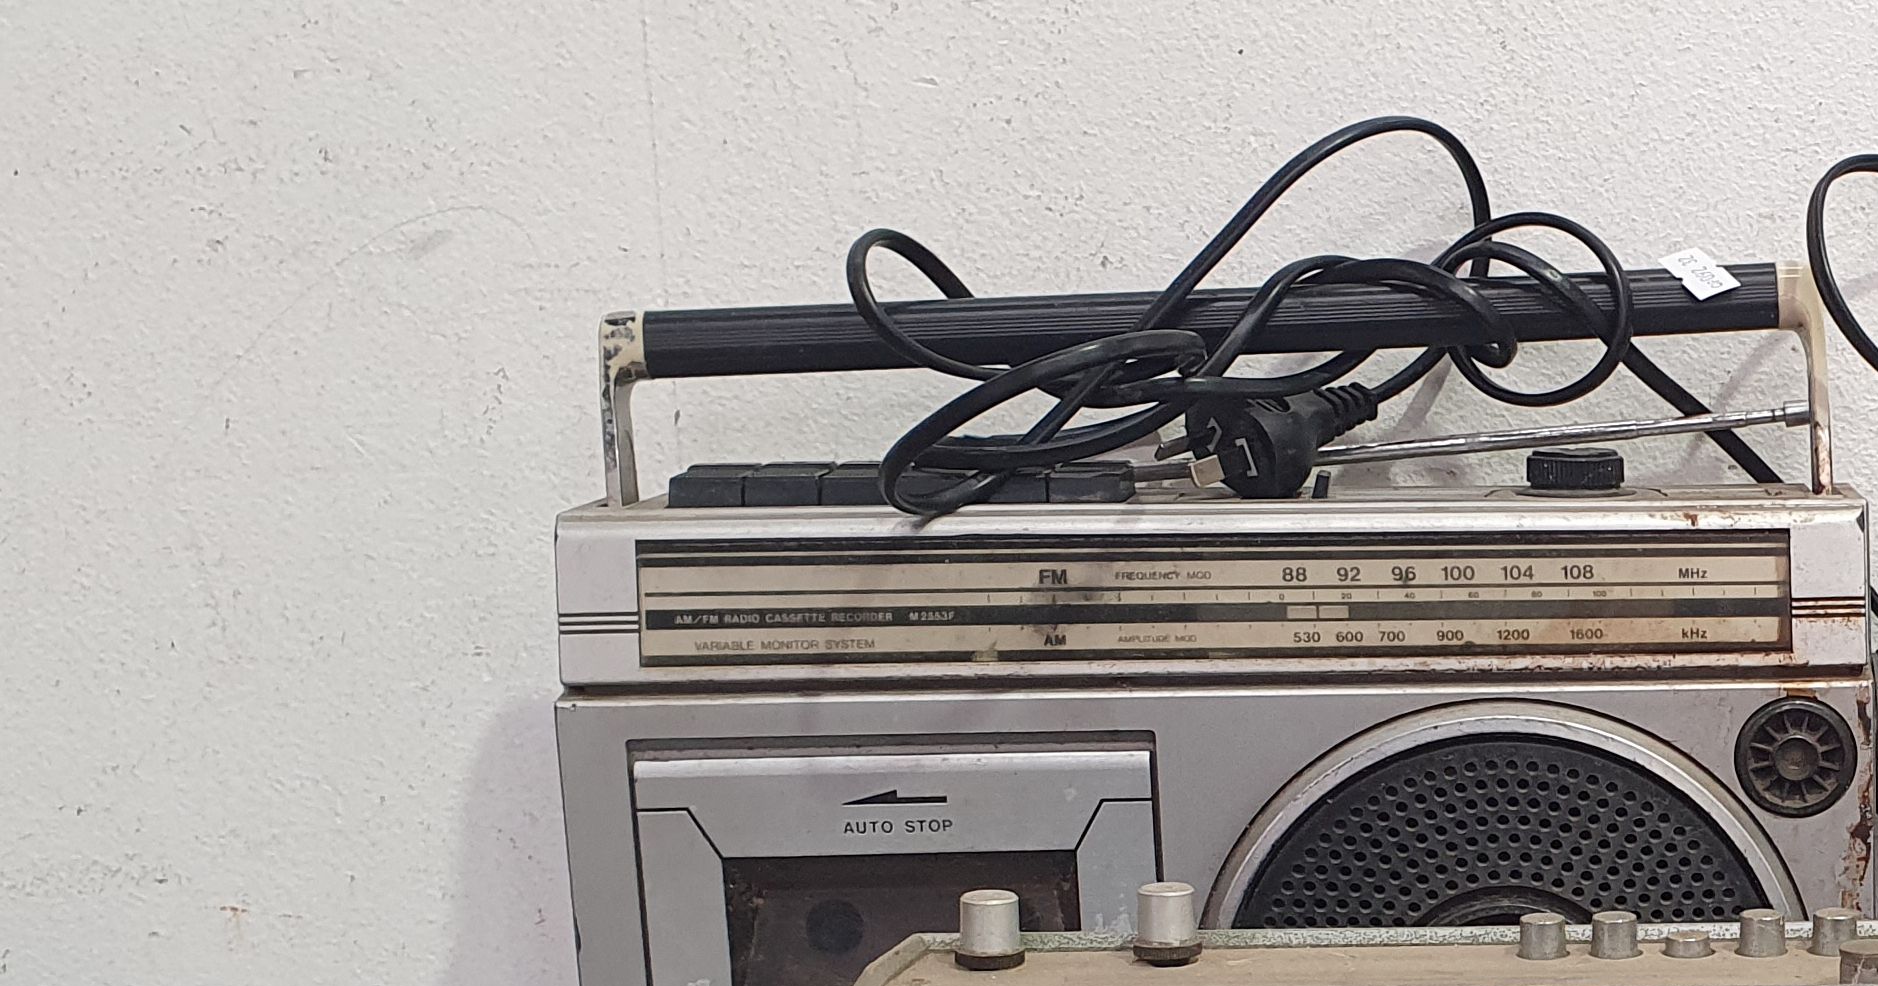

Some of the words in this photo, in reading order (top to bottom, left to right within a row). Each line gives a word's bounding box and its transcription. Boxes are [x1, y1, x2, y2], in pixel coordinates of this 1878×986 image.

[1039, 569, 1067, 585] FM
[1115, 571, 1180, 581] FREQUENCY
[1186, 570, 1212, 580] MOD
[1282, 566, 1307, 582] 88
[1336, 566, 1361, 582] 92
[1391, 565, 1416, 582] 96
[1441, 565, 1475, 581] 100
[1500, 564, 1535, 581] 104
[1560, 564, 1595, 580] 108
[1678, 567, 1708, 580] MHz
[1341, 592, 1353, 600] 20
[1404, 592, 1416, 600] 40
[1592, 590, 1607, 598] 100
[673, 614, 719, 625] AM/FM
[724, 613, 760, 624] RADIO
[766, 612, 825, 624] CASSETTE
[831, 612, 893, 622] RECORDER
[1043, 634, 1067, 647] AM
[1174, 634, 1197, 643] MOD
[1293, 631, 1321, 644] 530
[1336, 631, 1364, 643] 600
[1379, 630, 1406, 643] 700
[1436, 629, 1465, 642] 900
[1497, 628, 1530, 641] 1200
[1569, 628, 1604, 640] 1600
[1681, 627, 1708, 640] kHz
[695, 640, 753, 651] VARIABLE
[761, 639, 820, 650] MONITOR
[824, 639, 876, 650] SYSTEM
[843, 820, 894, 834] AUTO
[904, 819, 953, 833] STOP
